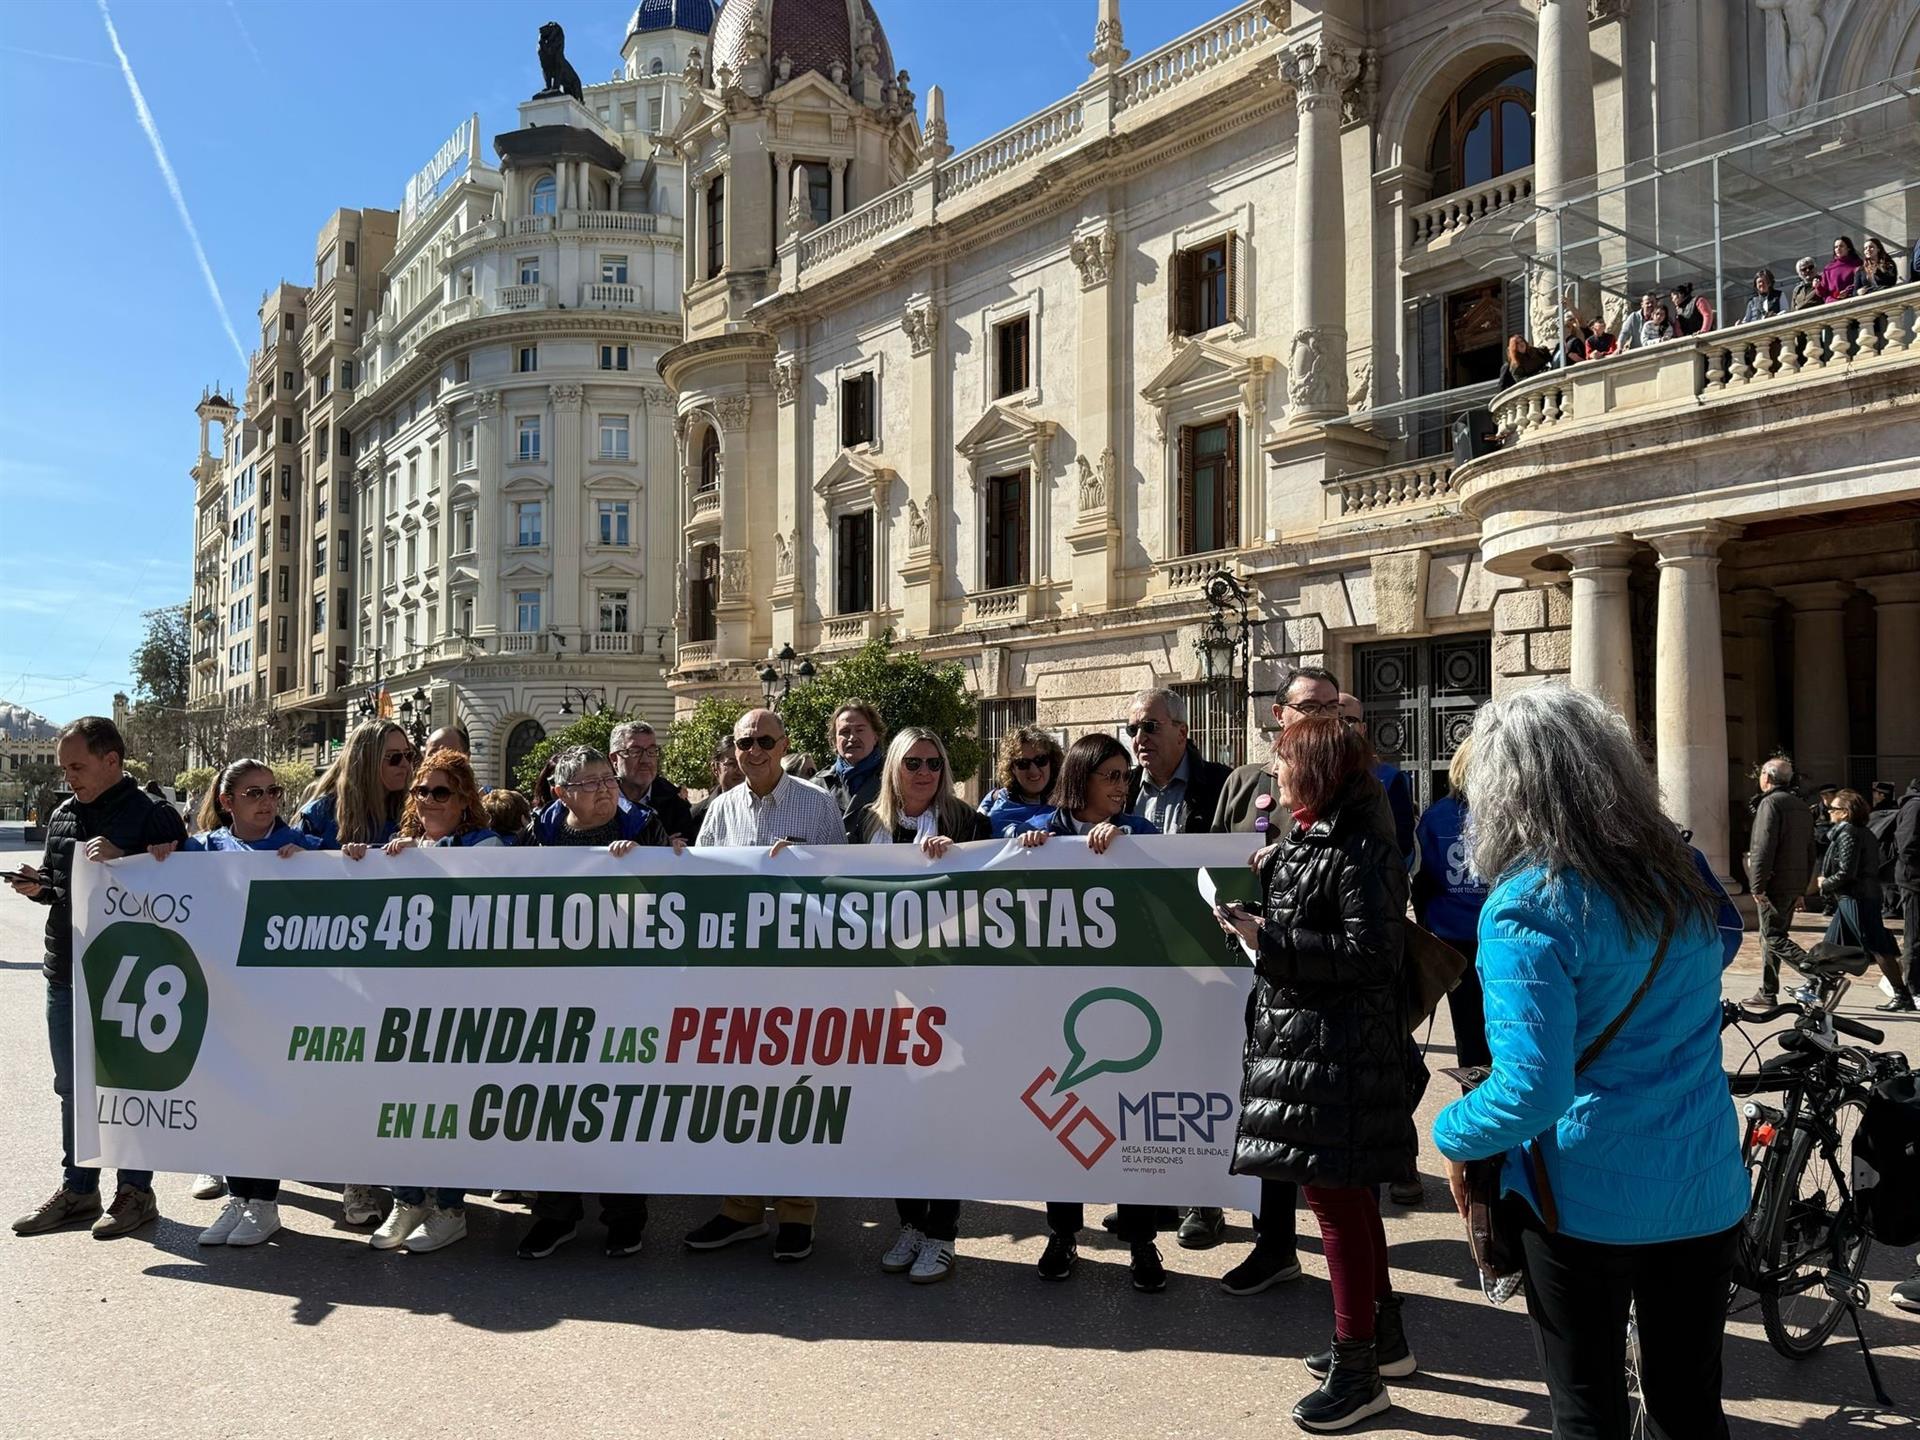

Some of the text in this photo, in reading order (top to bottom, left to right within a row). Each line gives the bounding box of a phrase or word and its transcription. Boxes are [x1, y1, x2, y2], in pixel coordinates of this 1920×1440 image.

[418, 120, 466, 200] GENERALI
[464, 663, 593, 679] EDIFICIO GENERALI
[265, 887, 1116, 950] SOMOS 48 MILLONES DE PENSIONISTAS
[101, 955, 186, 1053] 48
[288, 1007, 946, 1066] PARA BLINDAR LAS PENSIONES
[377, 1075, 852, 1144] EN LA CONSTITUCIÓN
[1117, 1091, 1233, 1142] MERP
[1121, 1146, 1230, 1157] MESA ESTATAL POR EL BLINDAJE
[1122, 1155, 1184, 1165] DE LA PENSIONES
[1123, 1167, 1166, 1175] www.merp.es
